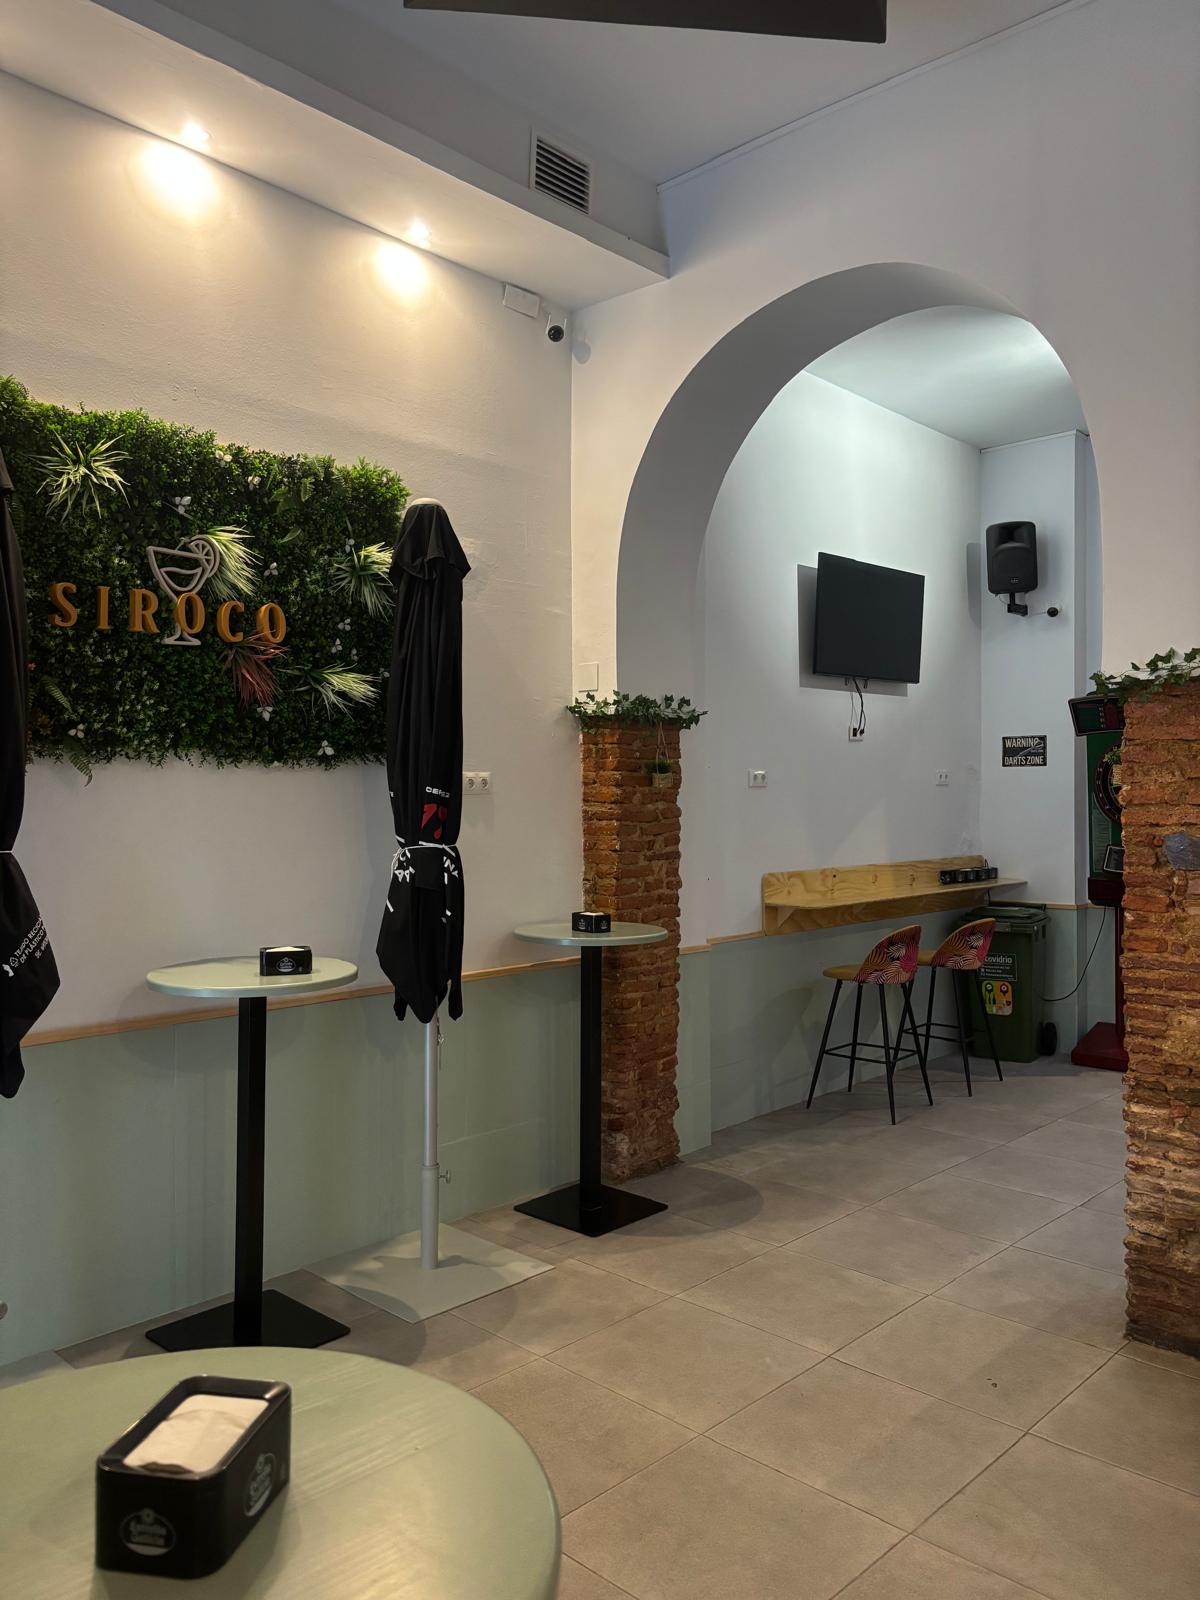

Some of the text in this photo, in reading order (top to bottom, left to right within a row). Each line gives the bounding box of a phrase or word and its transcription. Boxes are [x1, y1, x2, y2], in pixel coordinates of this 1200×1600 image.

[48, 581, 287, 643] SIROCO
[1004, 755, 1044, 765] DARTS ZONE
[984, 954, 1013, 964] covidrio
